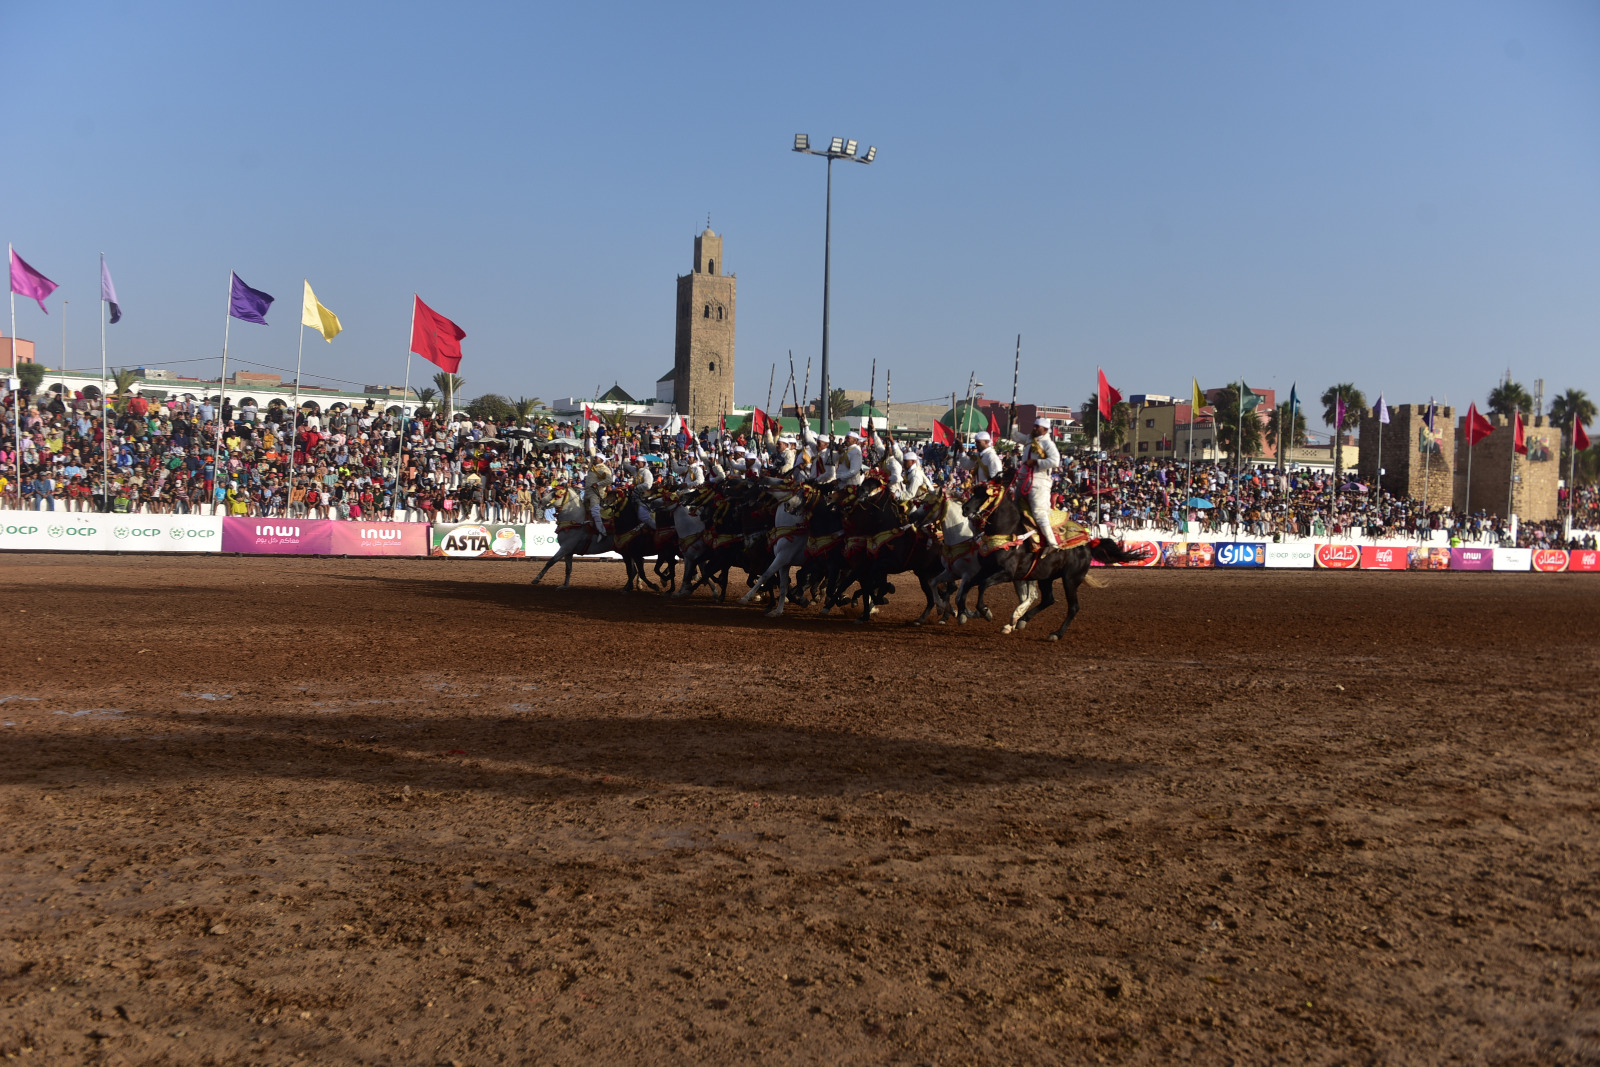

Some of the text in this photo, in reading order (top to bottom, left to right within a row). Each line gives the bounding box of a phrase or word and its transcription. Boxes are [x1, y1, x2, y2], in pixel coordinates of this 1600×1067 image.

[6, 525, 38, 535] OCP
[66, 527, 97, 536] OCP
[131, 528, 161, 537] OCP
[187, 529, 215, 538] OCP
[444, 535, 490, 551] ASTA
[1217, 544, 1254, 565] داري
